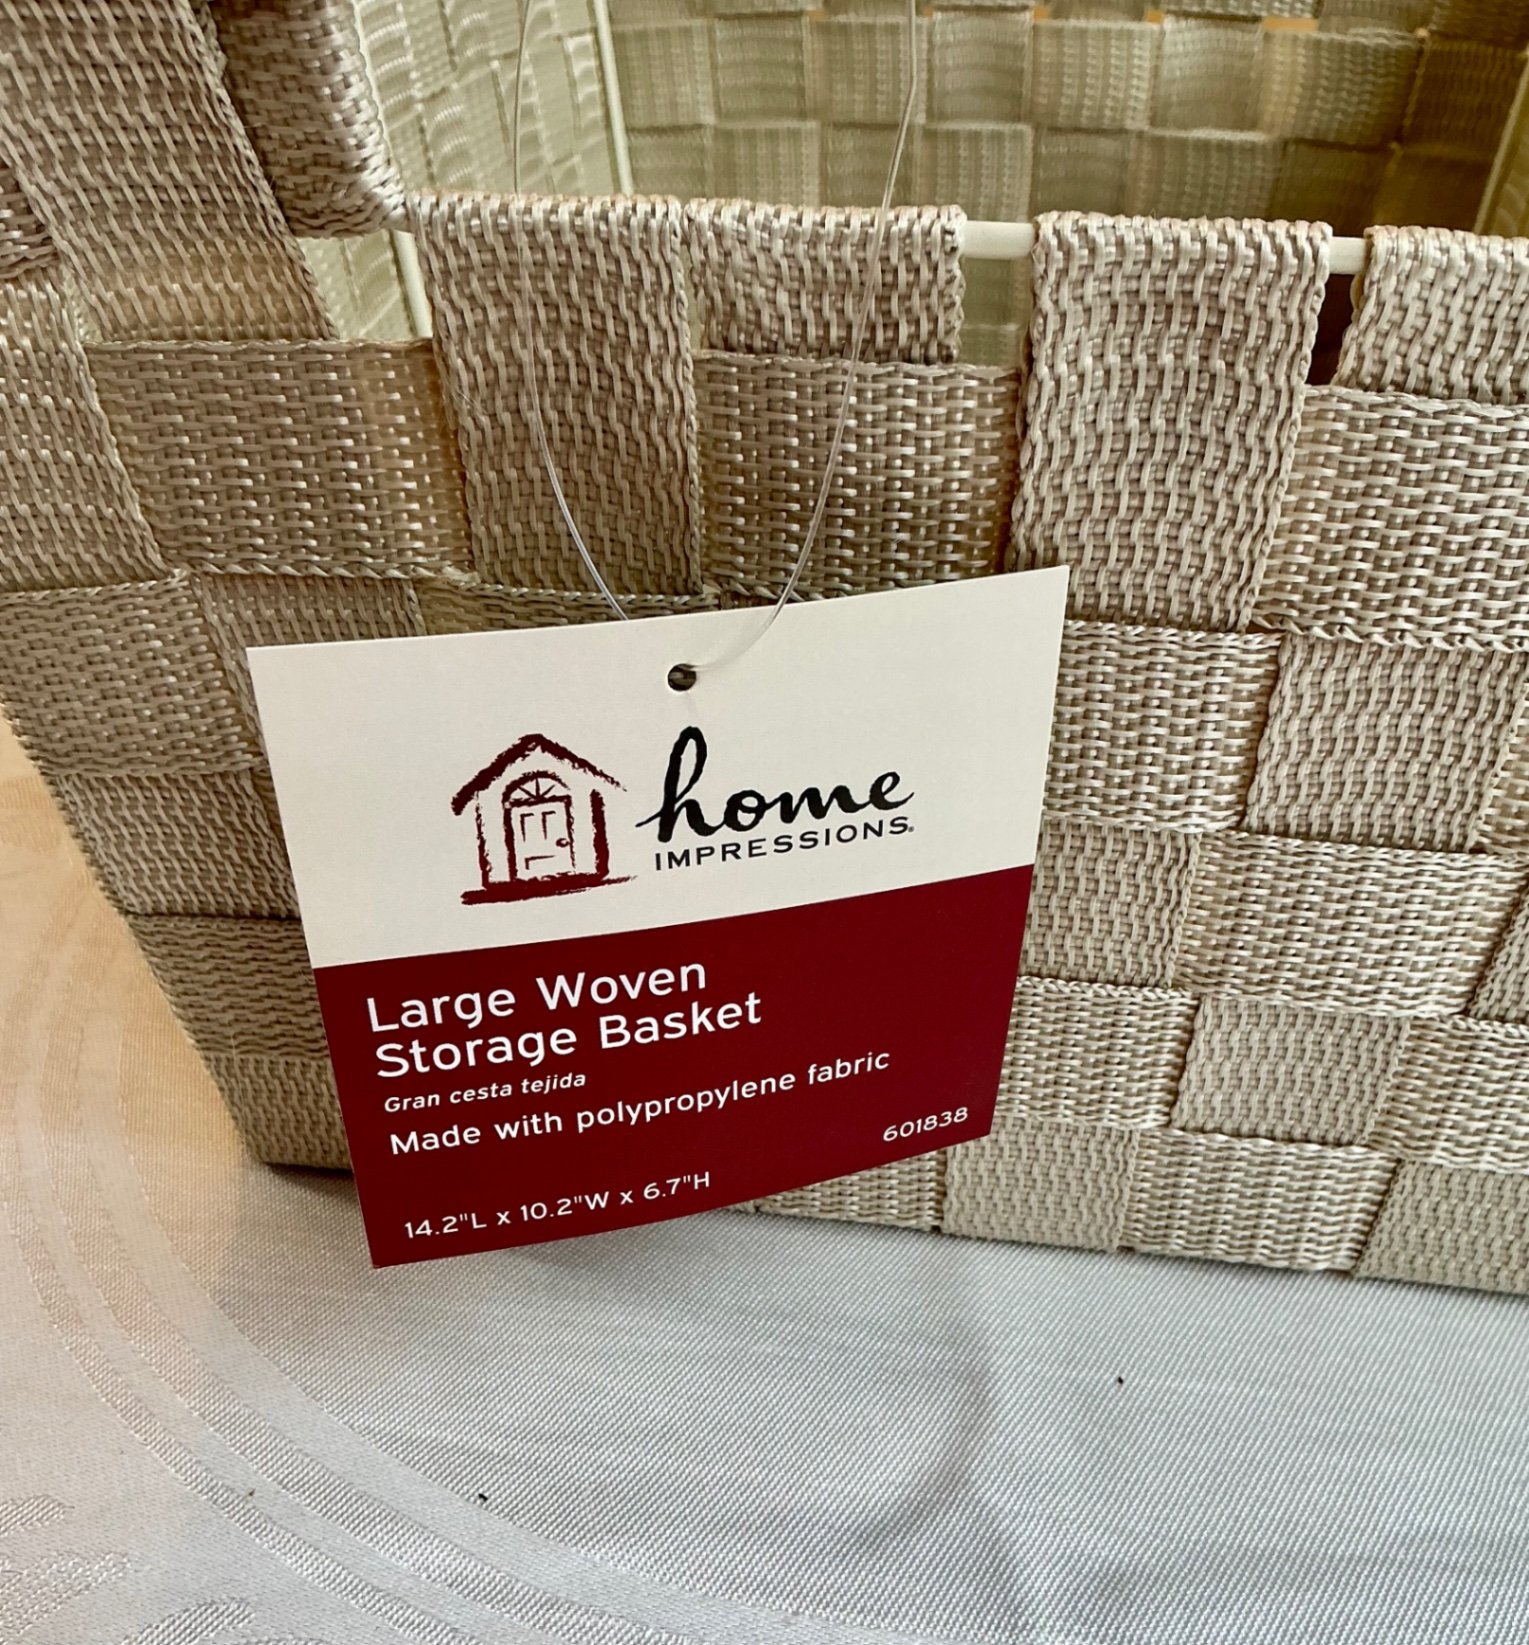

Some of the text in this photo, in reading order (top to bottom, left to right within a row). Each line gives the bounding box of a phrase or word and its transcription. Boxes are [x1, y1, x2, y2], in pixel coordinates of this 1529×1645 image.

[635, 725, 915, 843] home
[366, 963, 706, 1032] Large Woven
[375, 992, 762, 1078] Storage Basket
[384, 1072, 587, 1113] Gran cesta tejida
[389, 1051, 891, 1155] Made with polypropylene fabric
[883, 1106, 969, 1142] 601838
[404, 1171, 711, 1239] 14.2"L x 10.2"W x 6.7"H
